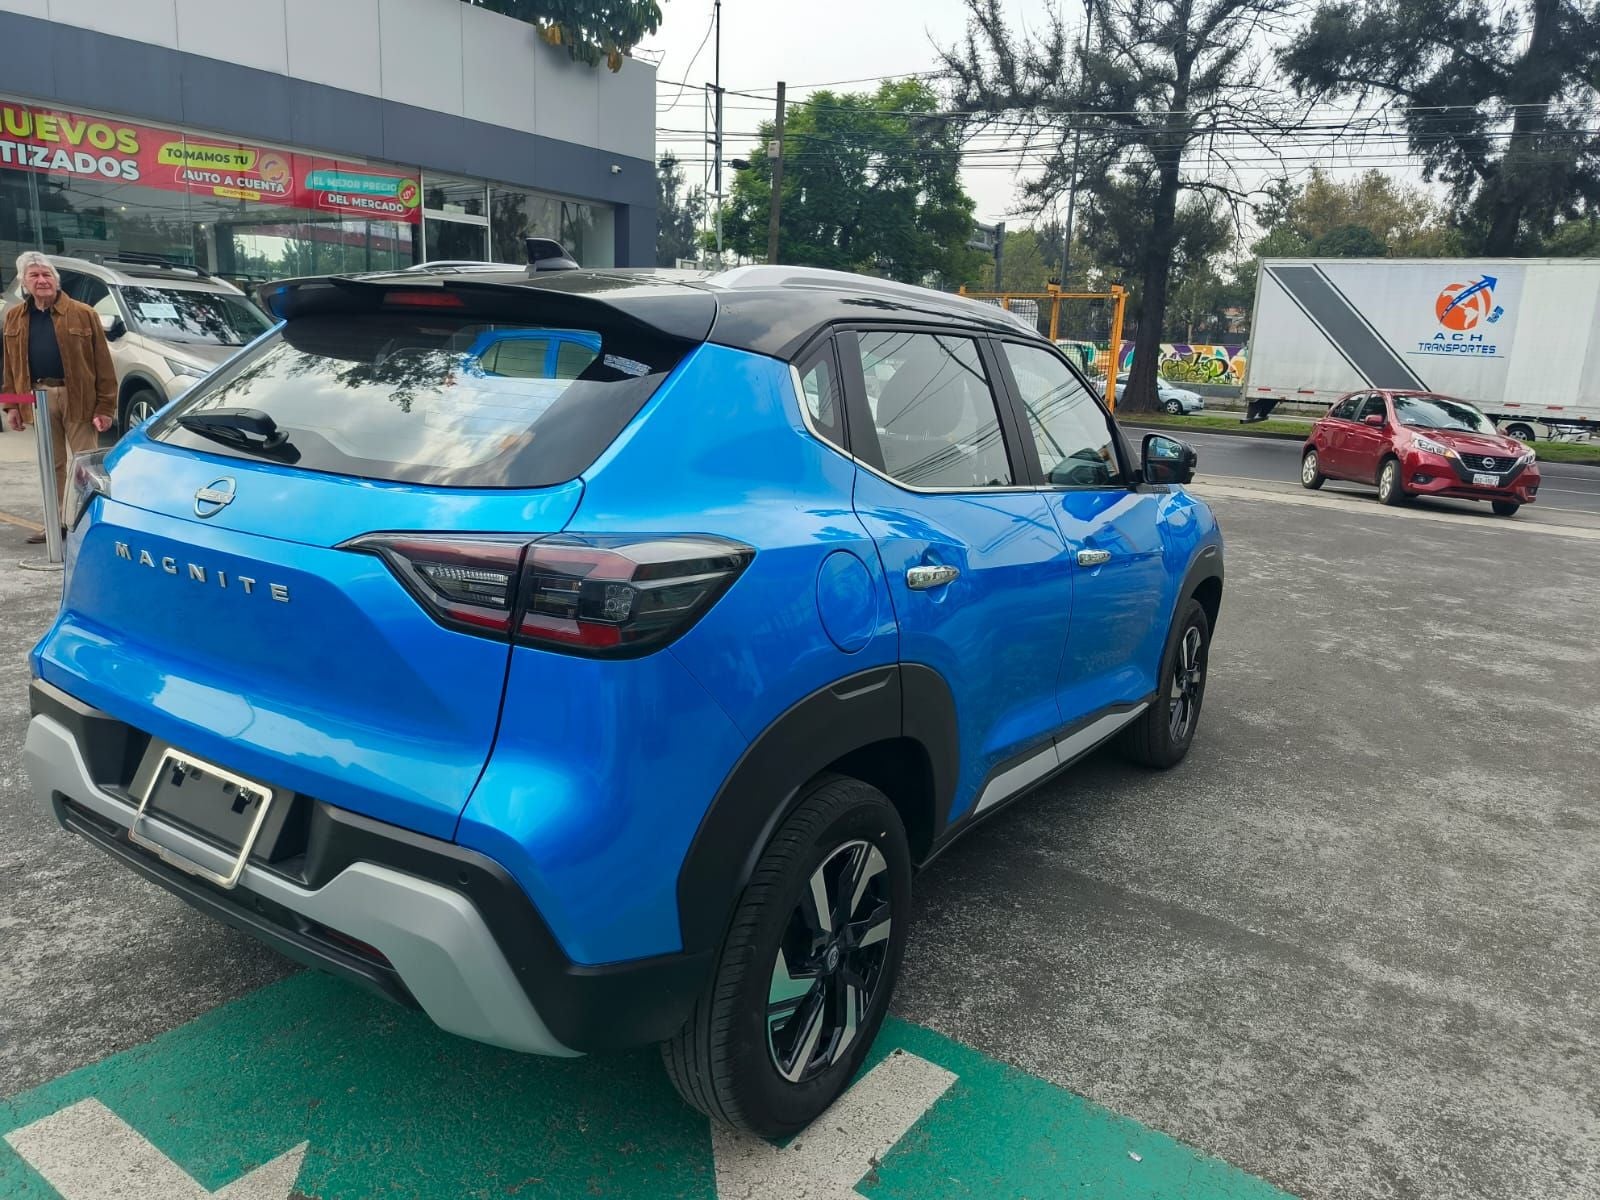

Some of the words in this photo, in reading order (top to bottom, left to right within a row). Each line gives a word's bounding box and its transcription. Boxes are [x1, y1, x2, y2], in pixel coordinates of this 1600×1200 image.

[0, 107, 139, 154] UEVOS
[0, 140, 140, 180] TIZADOS
[166, 148, 230, 163] TOMAMOS
[233, 155, 248, 165] TU
[183, 170, 220, 183] AUTO
[224, 175, 234, 185] A
[237, 177, 285, 193] CUENTA
[313, 176, 323, 186] EL
[327, 178, 359, 189] MEJOR
[362, 181, 397, 192] PRECIO
[327, 193, 349, 205] DEL
[352, 196, 404, 212] MERCADO
[1418, 342, 1497, 354] TRANSPORTES
[115, 540, 290, 603] MAGNITE
